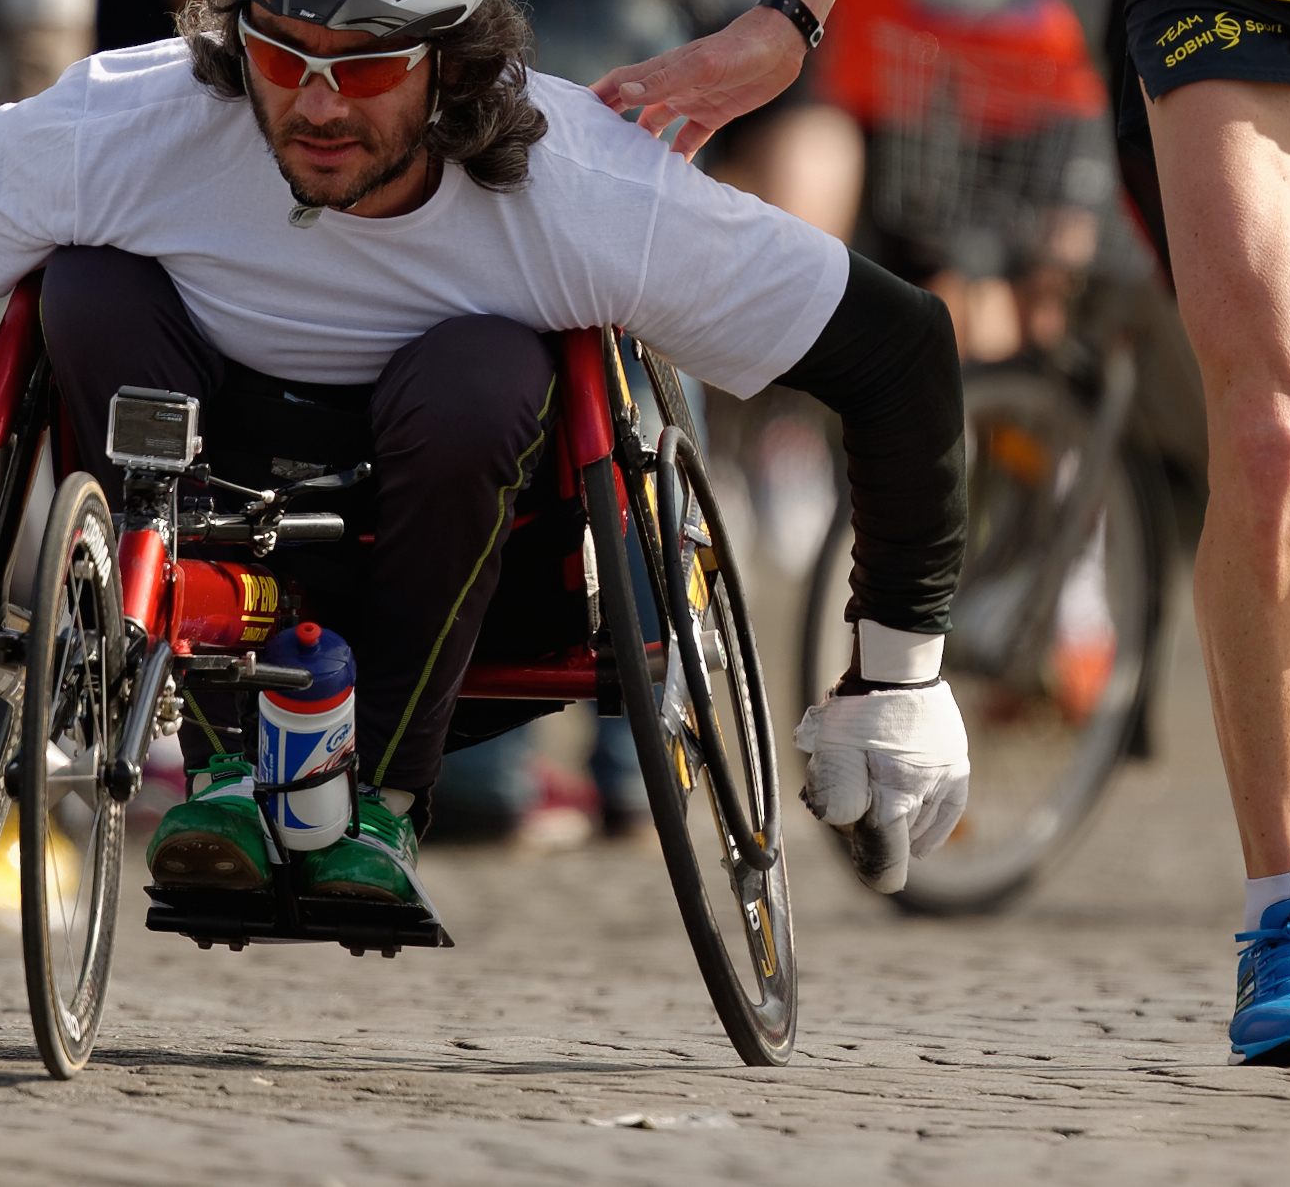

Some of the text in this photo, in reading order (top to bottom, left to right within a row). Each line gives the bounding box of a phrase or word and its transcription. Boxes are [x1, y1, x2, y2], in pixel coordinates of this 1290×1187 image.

[1156, 15, 1203, 47] TEAM
[1165, 20, 1282, 68] SOBHI Sport
[240, 574, 278, 612] TOP END
